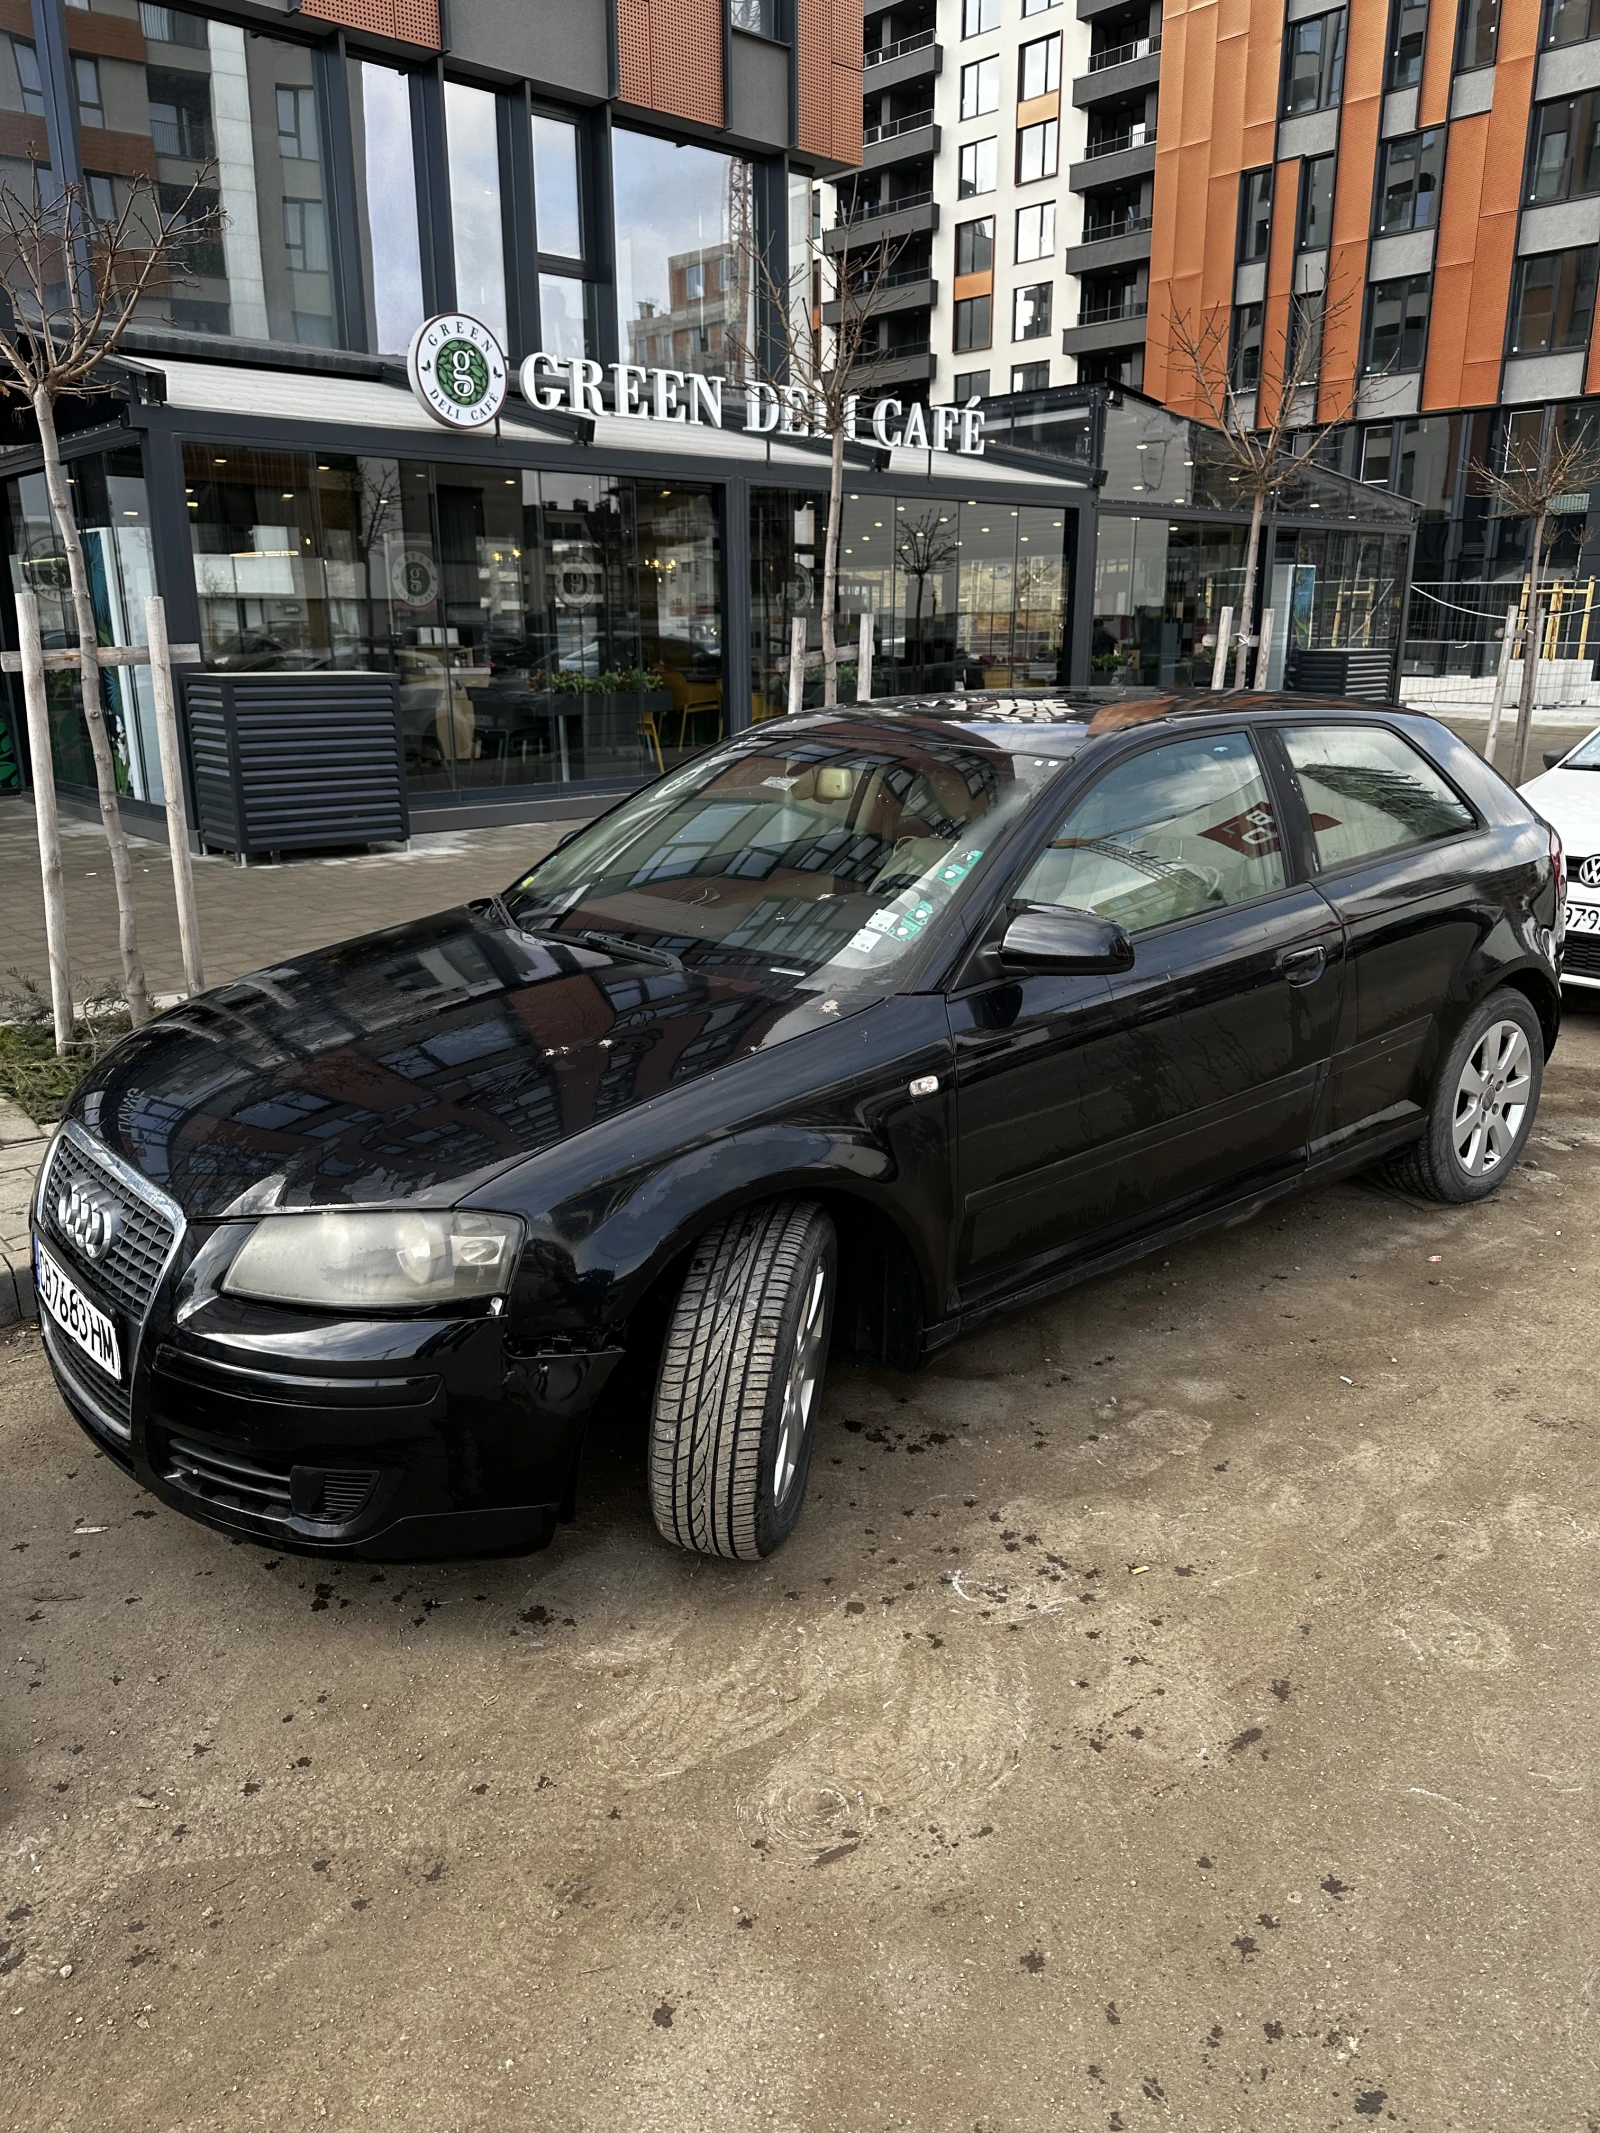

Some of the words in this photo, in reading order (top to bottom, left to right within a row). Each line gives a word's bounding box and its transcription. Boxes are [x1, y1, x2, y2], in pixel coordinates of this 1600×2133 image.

[427, 321, 493, 353] GREEN
[452, 350, 476, 397] g
[429, 388, 460, 419] DELI
[469, 391, 500, 421] CAFÉ
[519, 352, 726, 429] GREEN
[742, 380, 861, 443] DELI
[872, 395, 986, 455] CAFÉ
